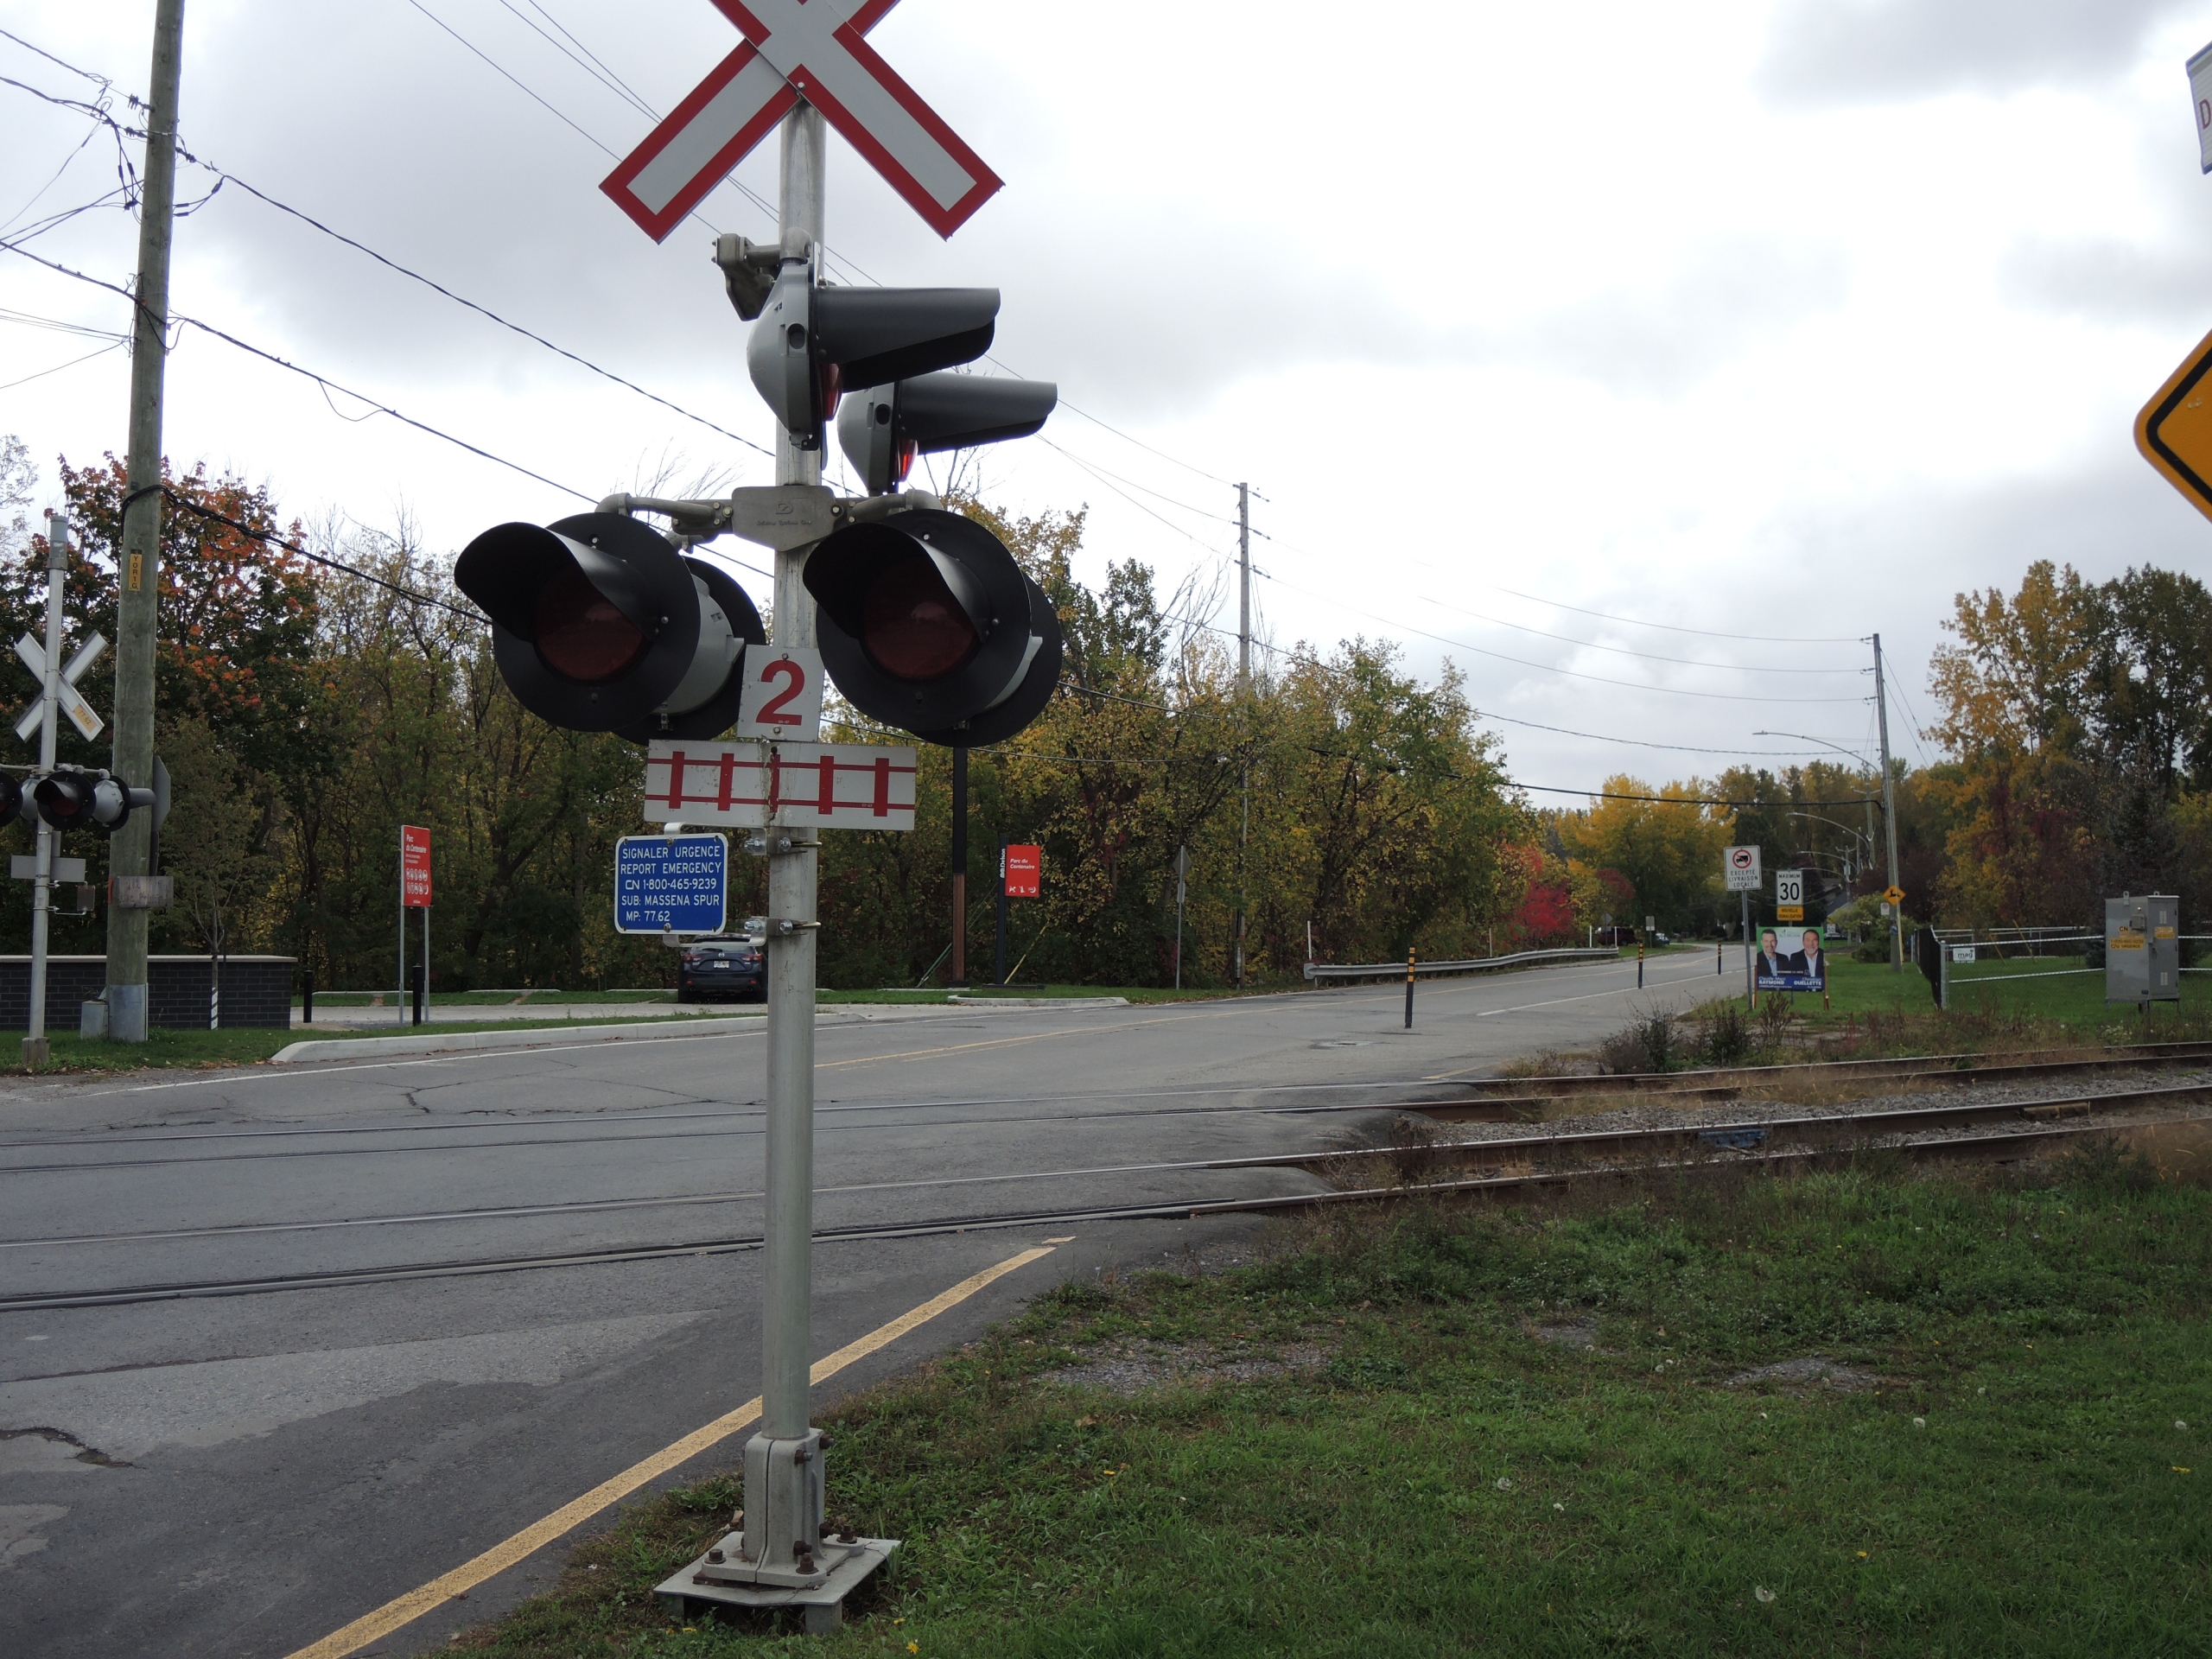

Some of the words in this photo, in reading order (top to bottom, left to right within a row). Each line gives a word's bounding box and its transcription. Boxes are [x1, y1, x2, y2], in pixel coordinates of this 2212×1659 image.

[755, 659, 805, 726] 2
[622, 847, 669, 859] SIGNALER
[675, 846, 721, 857] URGENCE
[620, 863, 657, 874] REPORT
[663, 862, 721, 874] EMERGENCY
[625, 880, 640, 890] CN
[643, 879, 717, 890] 1-800-465-9239
[1780, 882, 1800, 900] 30
[621, 895, 641, 906] SUB:
[645, 894, 690, 906] MASSENA
[693, 894, 720, 906] SPUR
[626, 911, 641, 922] MP:
[644, 911, 671, 922] 77.62
